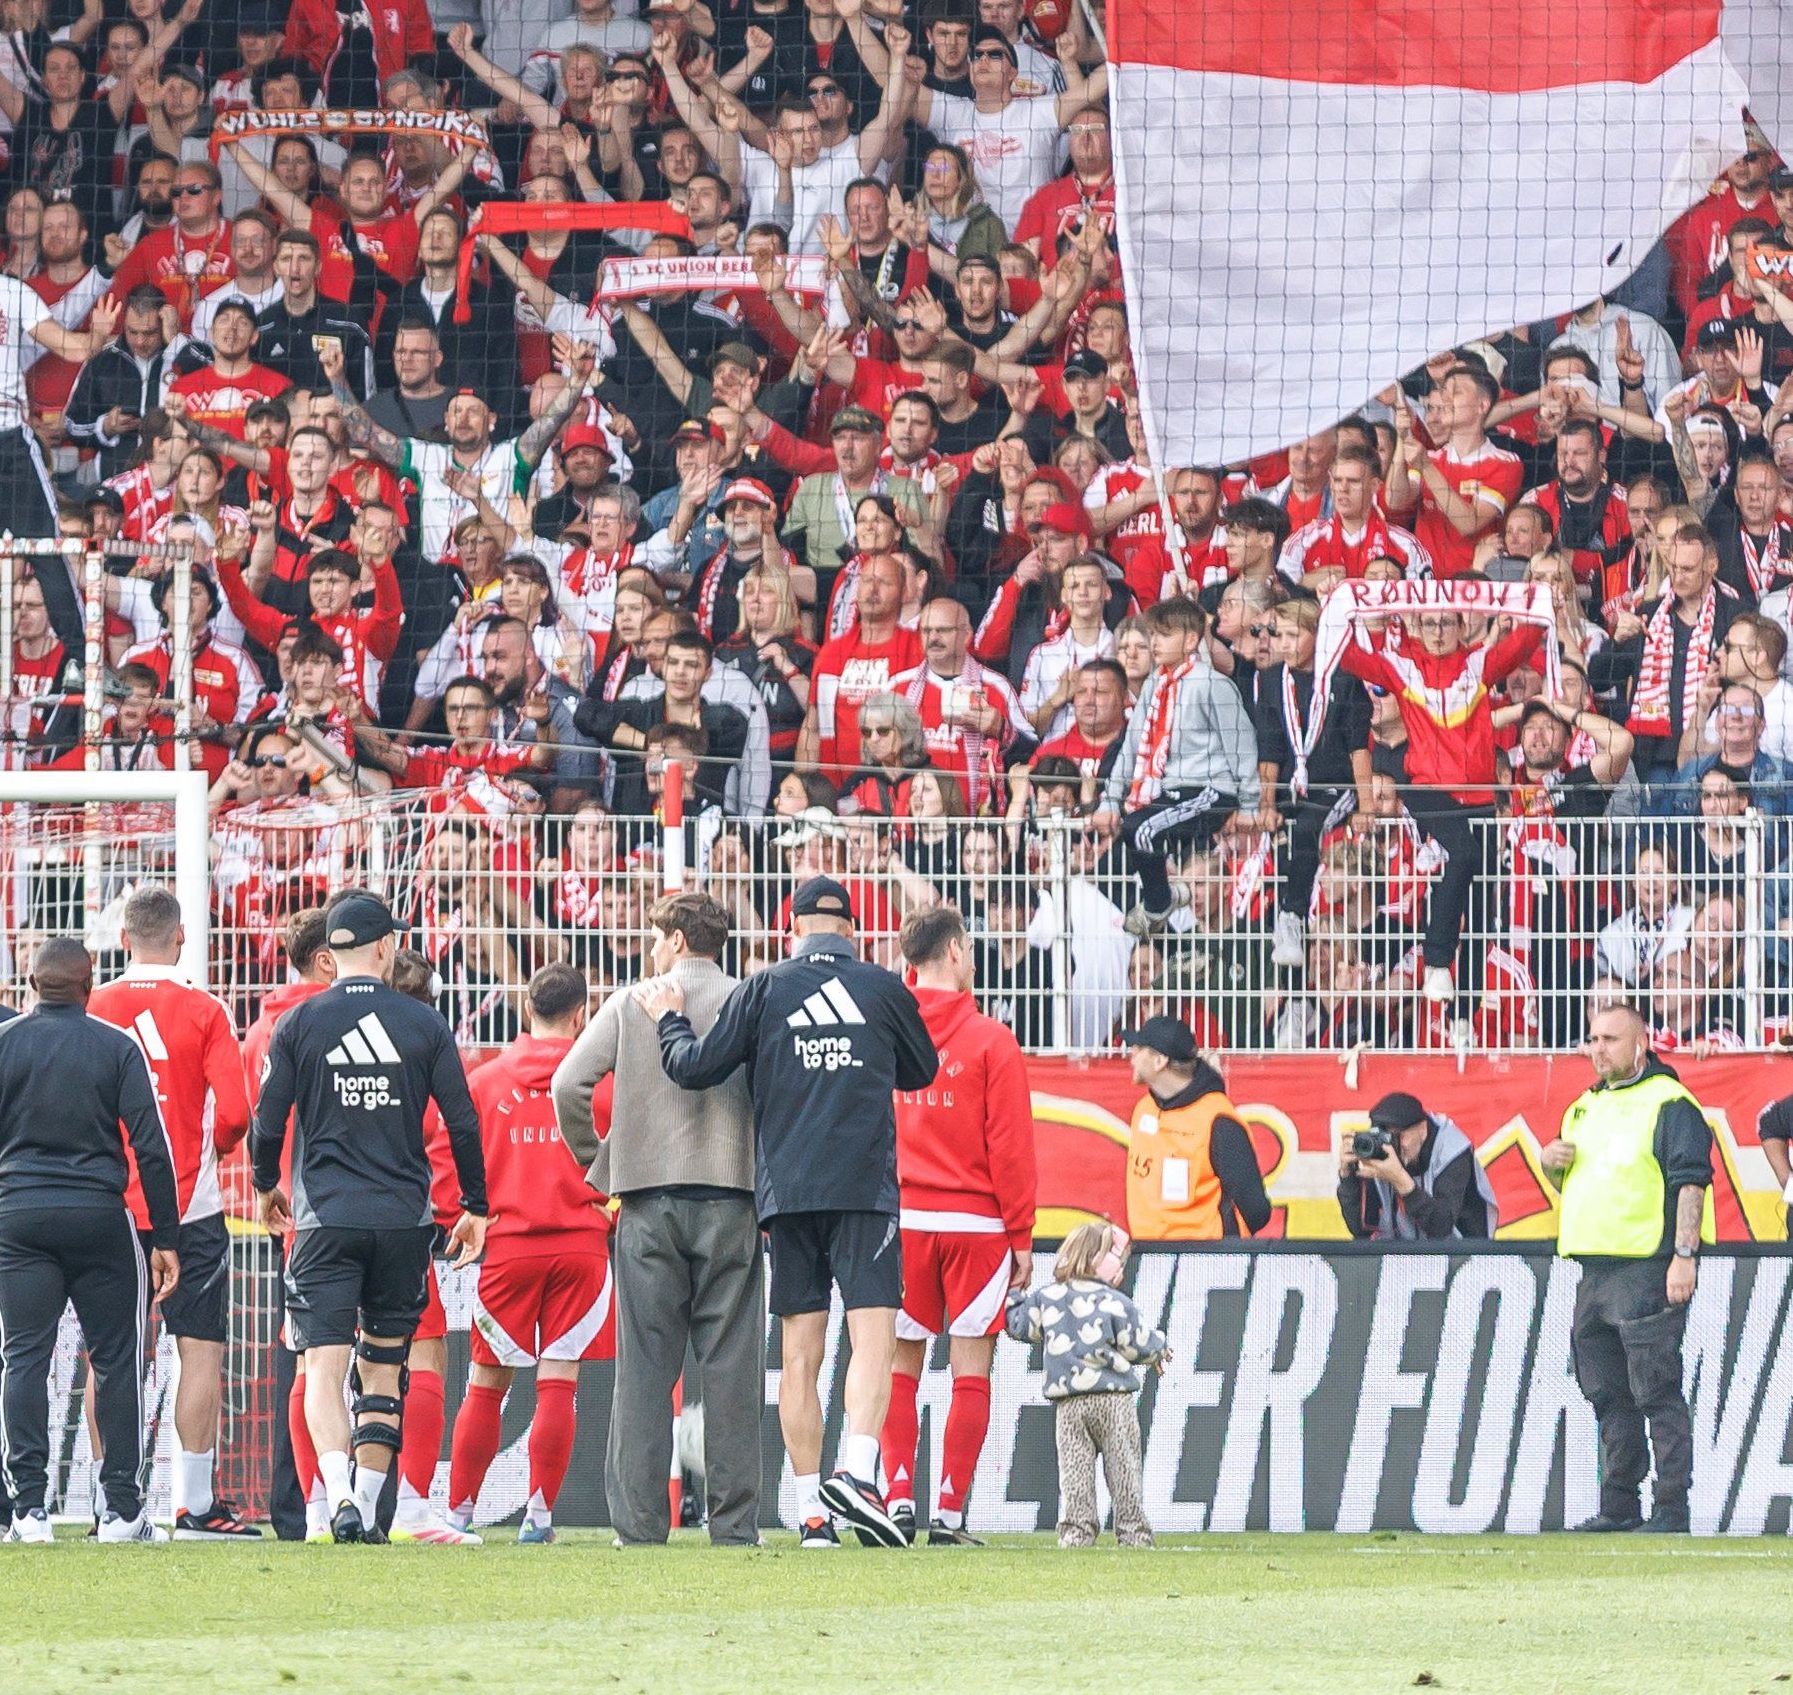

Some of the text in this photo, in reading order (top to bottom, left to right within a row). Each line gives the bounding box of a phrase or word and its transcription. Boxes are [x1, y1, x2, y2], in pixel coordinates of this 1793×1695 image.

[220, 111, 321, 135] WUHLE
[666, 259, 717, 274] UNION
[1350, 583, 1505, 609] RØNNOW
[793, 1034, 852, 1056] home
[802, 1051, 823, 1070] to
[334, 1071, 389, 1093] home
[341, 1090, 360, 1107] to
[895, 1090, 955, 1108] NION
[509, 1126, 561, 1145] UNIO
